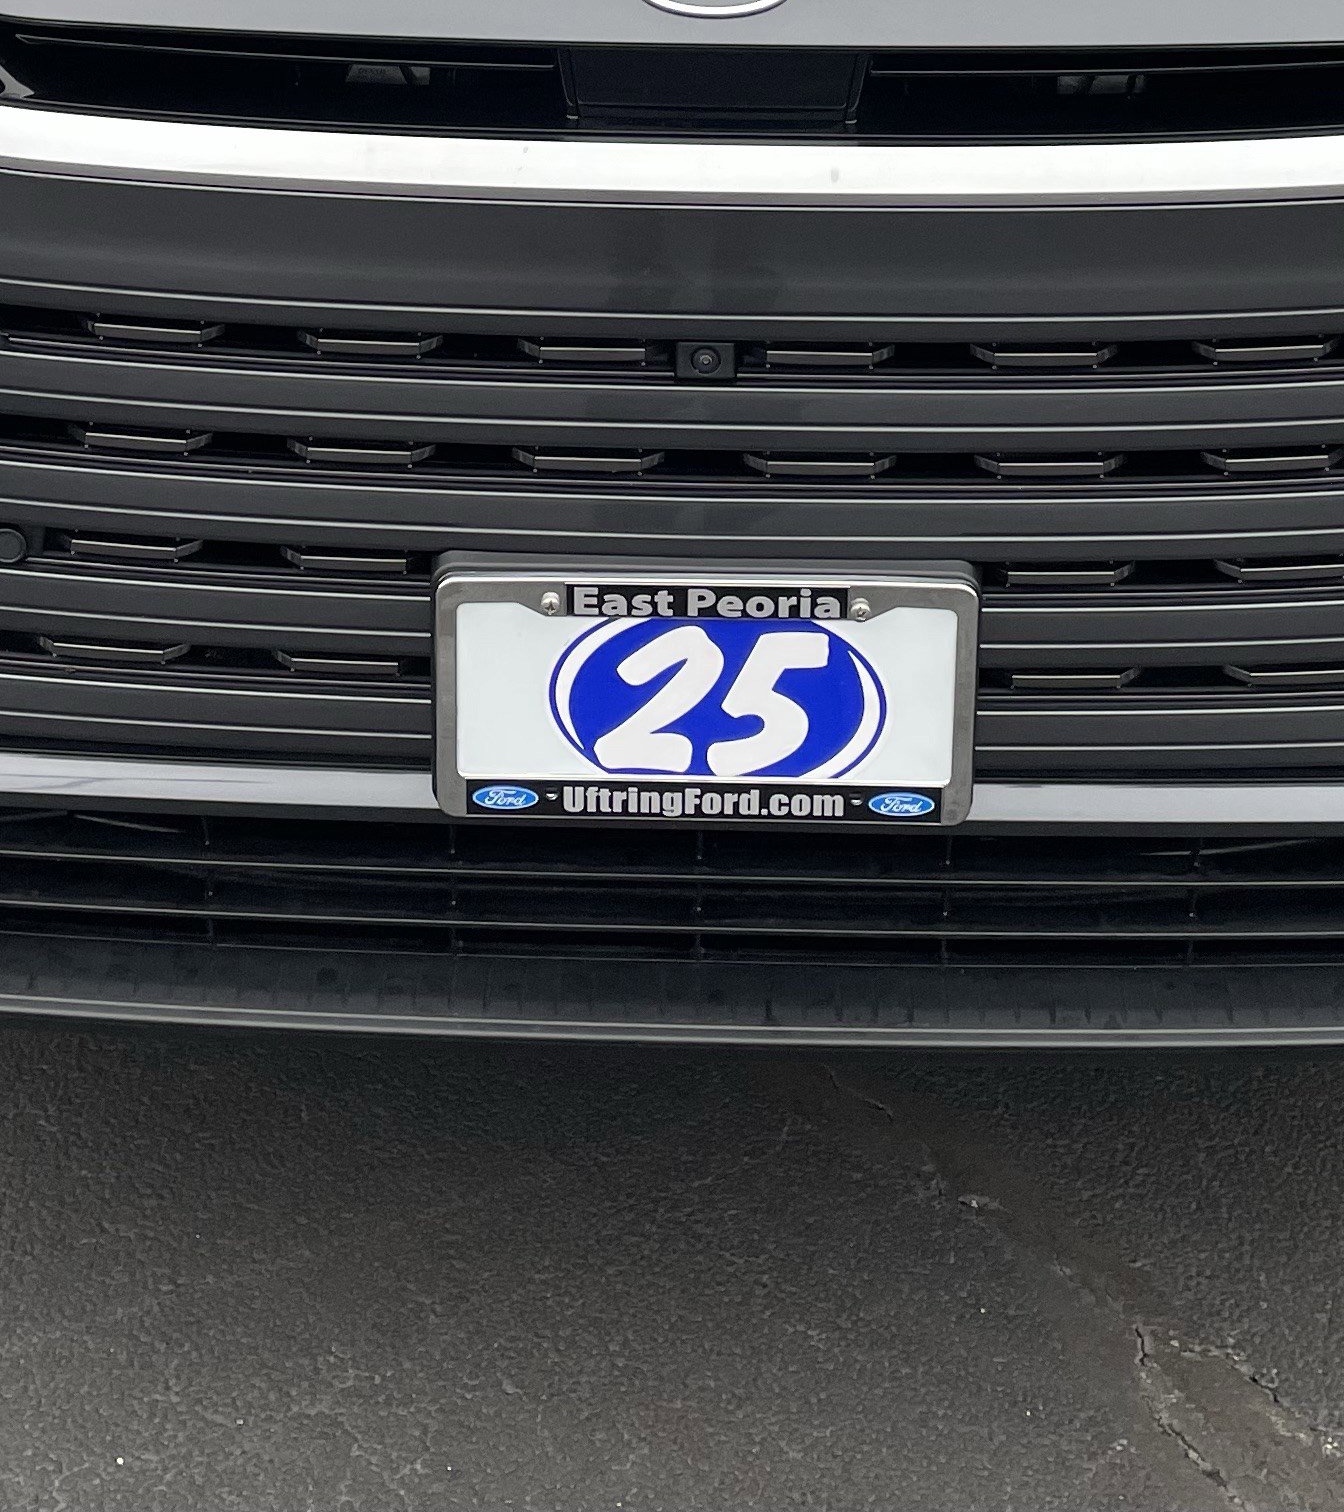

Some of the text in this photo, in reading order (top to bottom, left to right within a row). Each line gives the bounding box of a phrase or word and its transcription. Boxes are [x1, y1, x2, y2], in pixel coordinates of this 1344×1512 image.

[573, 586, 842, 619] East Peoria
[592, 624, 831, 776] 25
[484, 785, 924, 818] Ford UftringFord.com Ford
